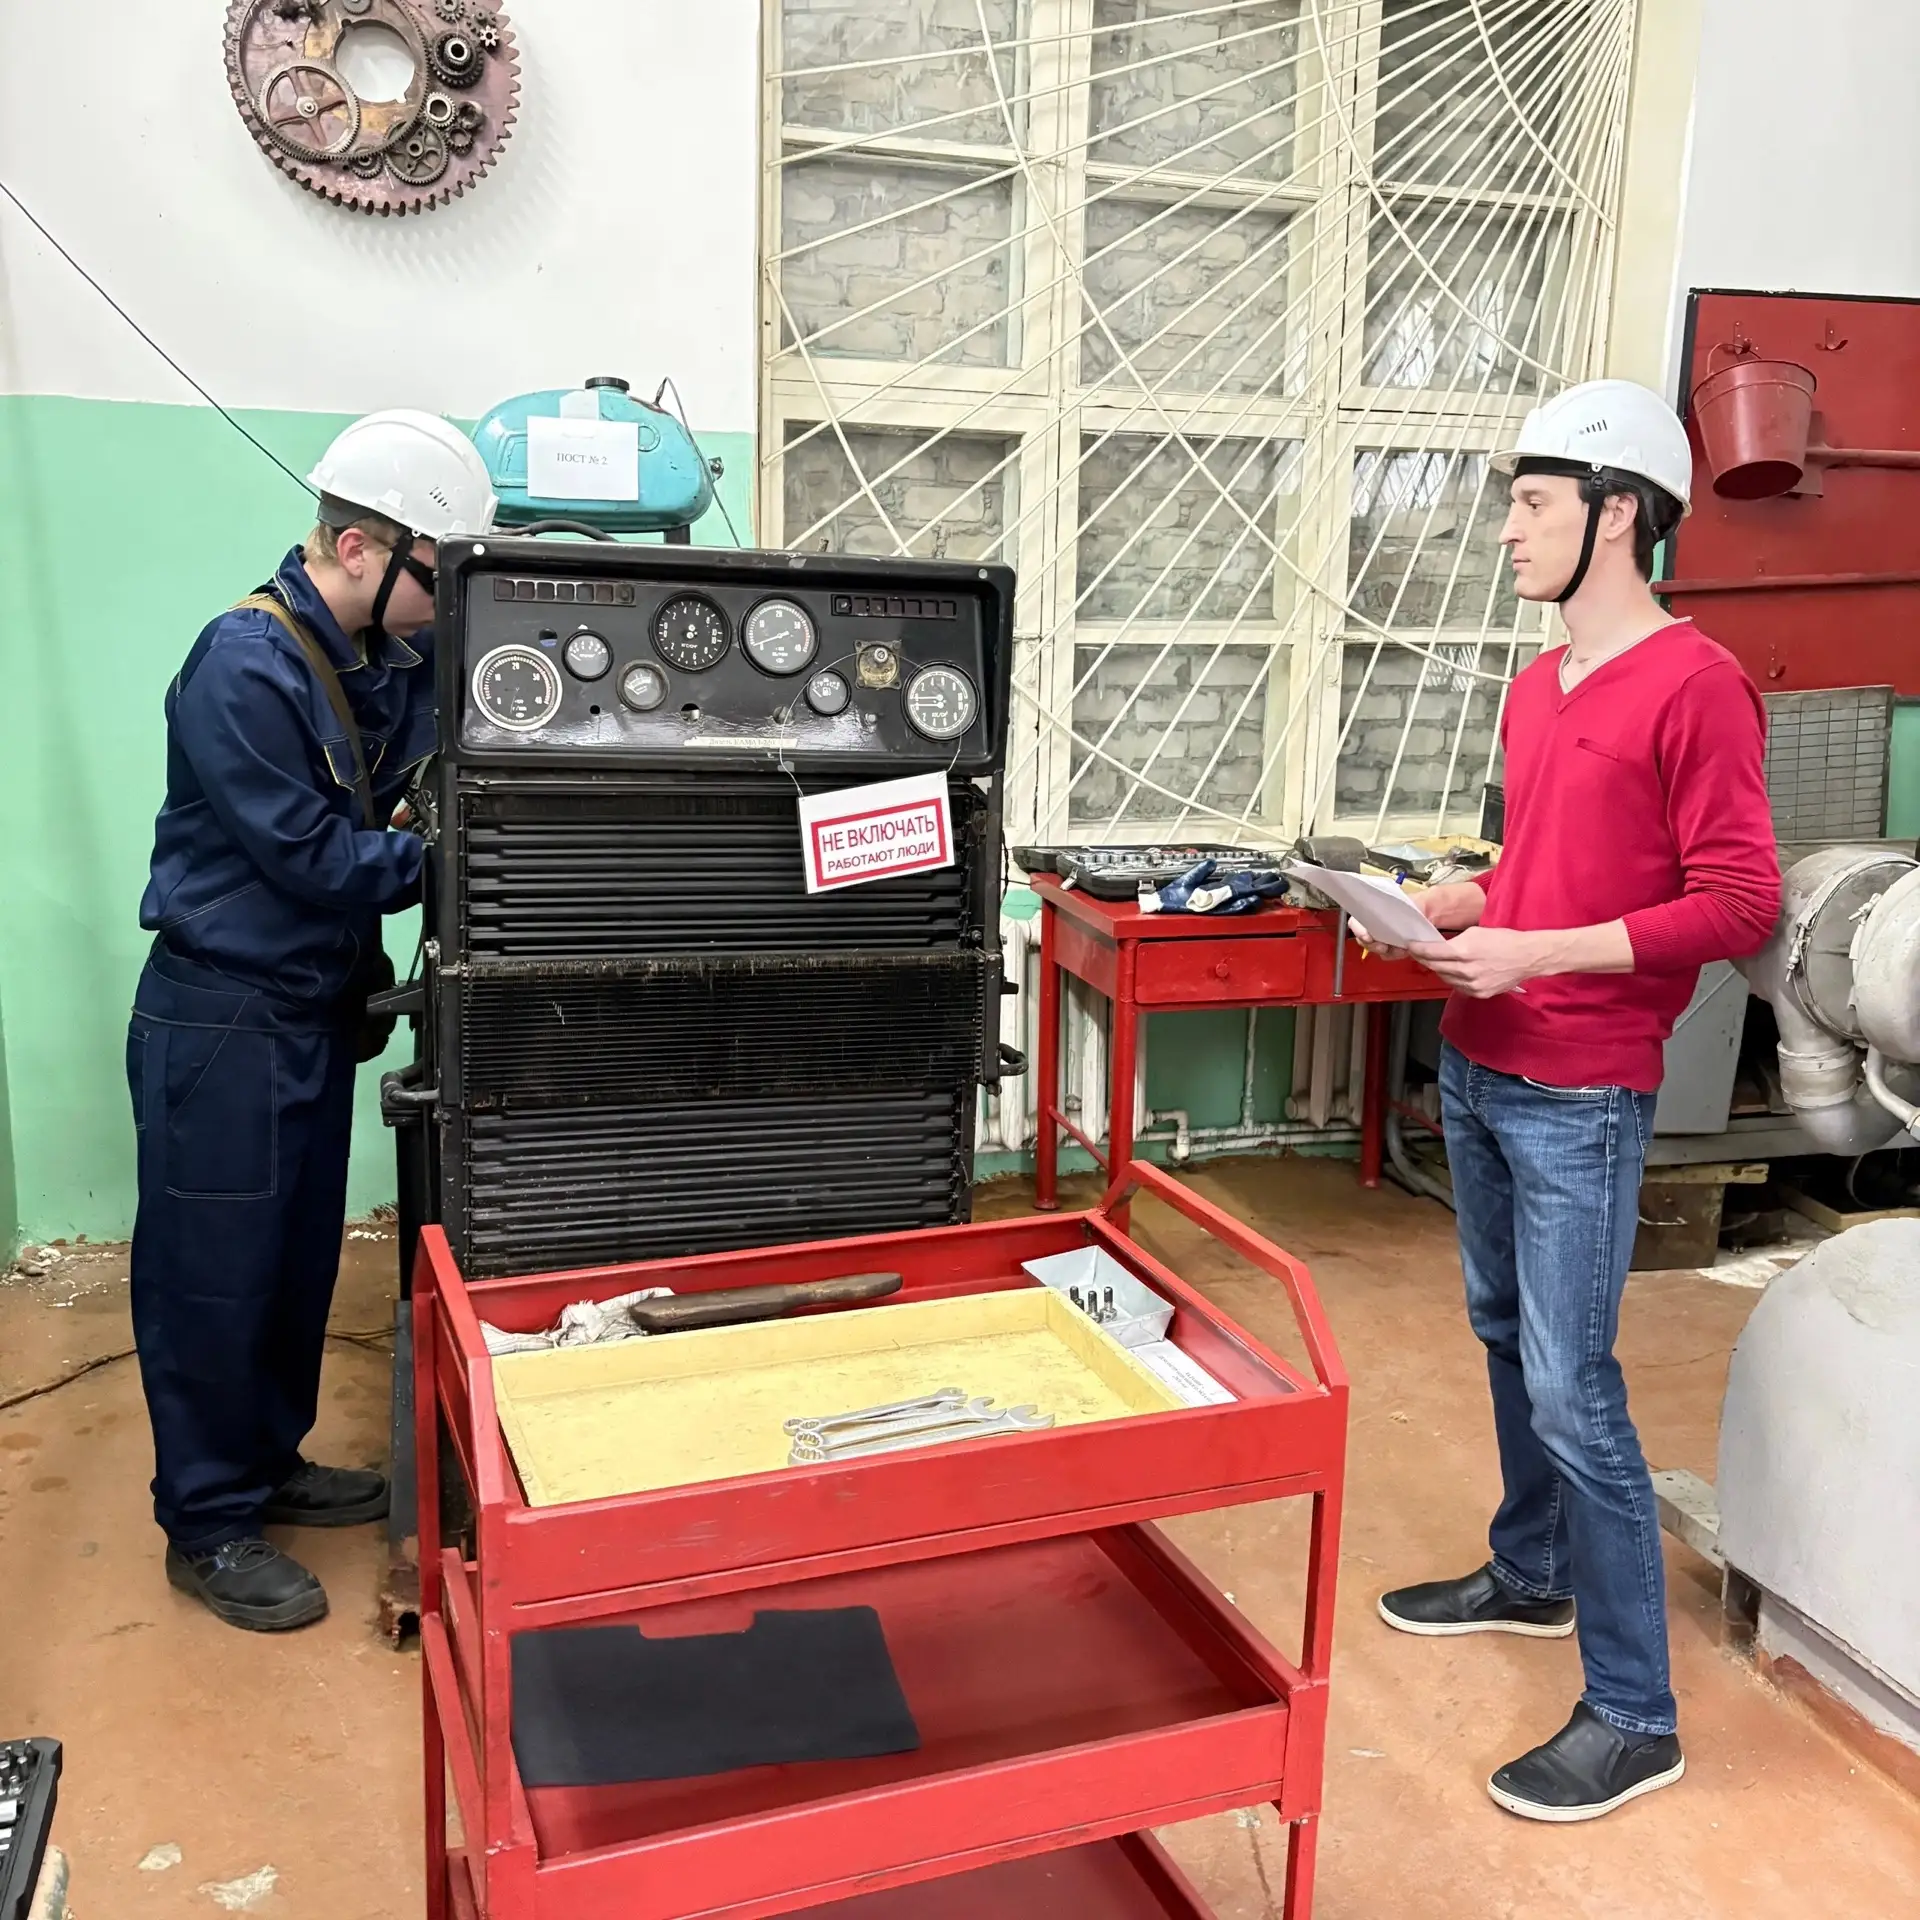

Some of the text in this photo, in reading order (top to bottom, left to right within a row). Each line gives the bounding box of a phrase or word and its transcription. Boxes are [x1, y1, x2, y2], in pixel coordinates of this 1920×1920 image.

[556, 452, 608, 465] ПОСТ № 2
[822, 815, 935, 852] НЕ ВКЛЮЧАТЬ
[828, 841, 935, 872] РАБОТАЮТ ЛЮДИ
